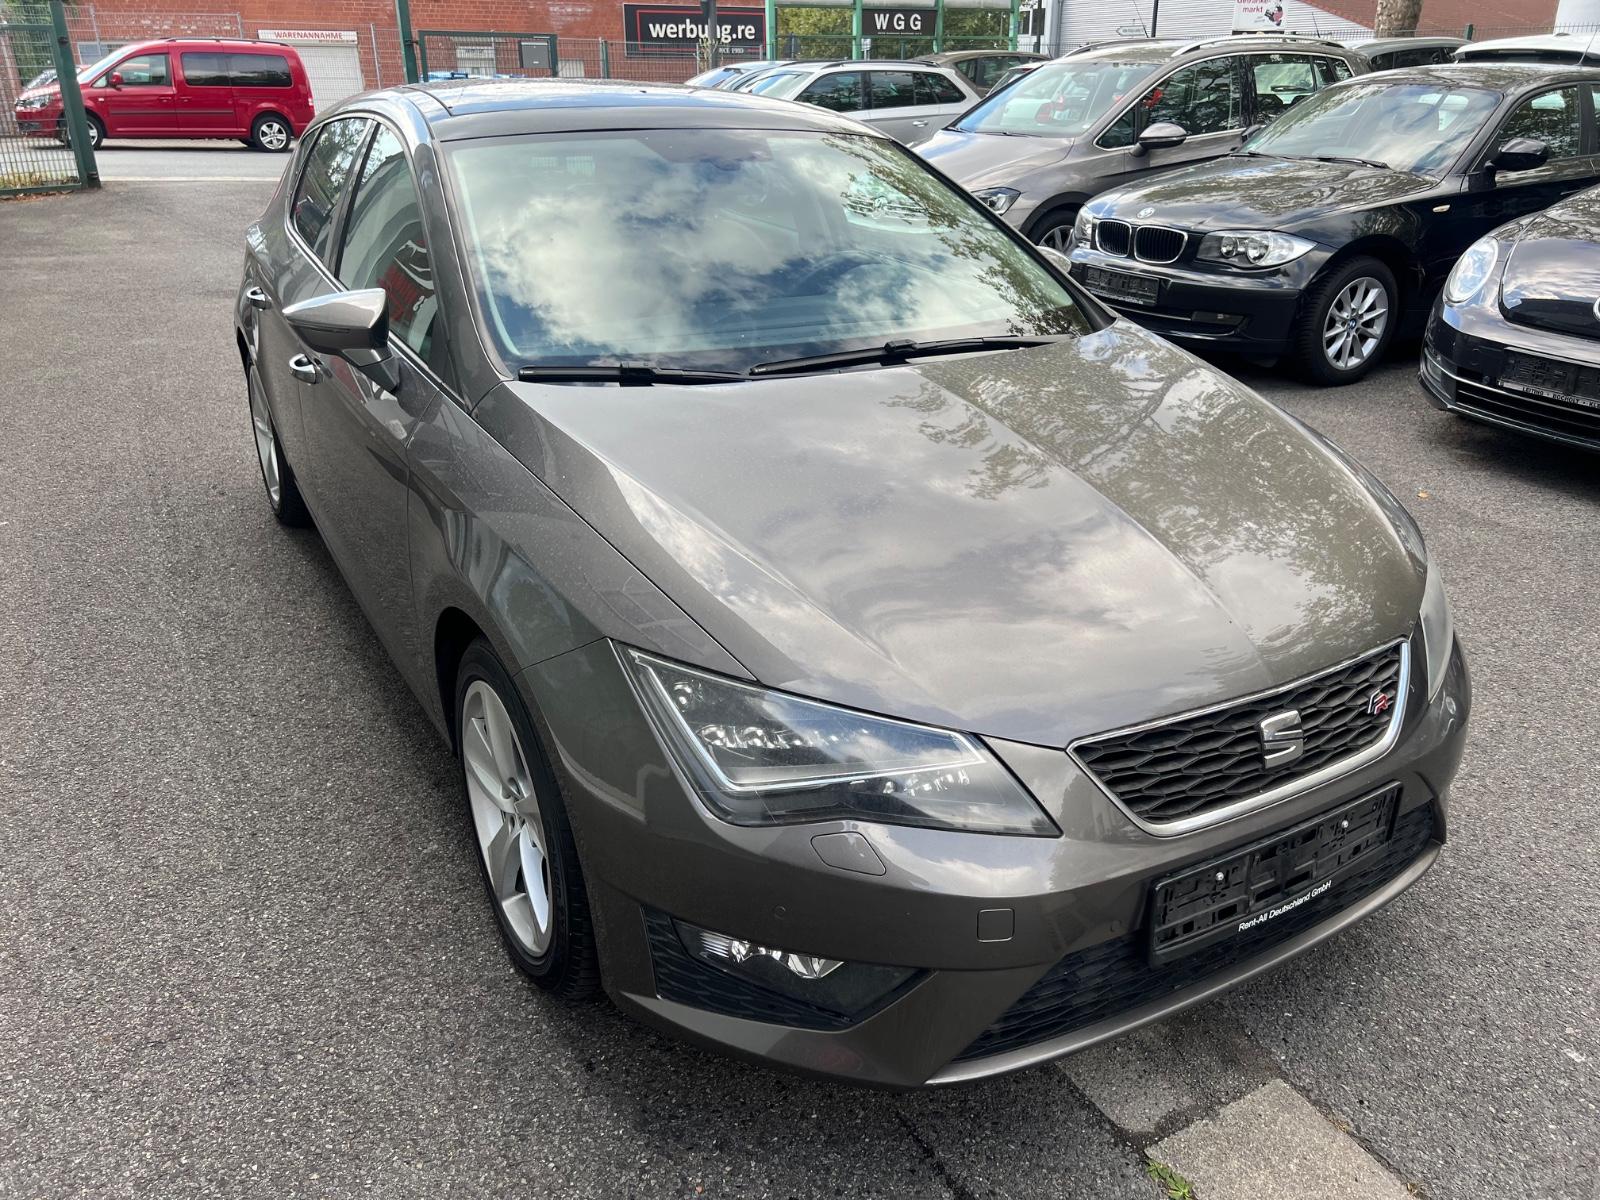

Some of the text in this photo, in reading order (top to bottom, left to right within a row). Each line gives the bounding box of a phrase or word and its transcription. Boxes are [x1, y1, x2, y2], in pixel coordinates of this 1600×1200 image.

[274, 31, 343, 40] WARENANNAHME
[648, 18, 756, 44] werbug.re
[1238, 879, 1332, 932] Rent-All Deutschland GmbH
